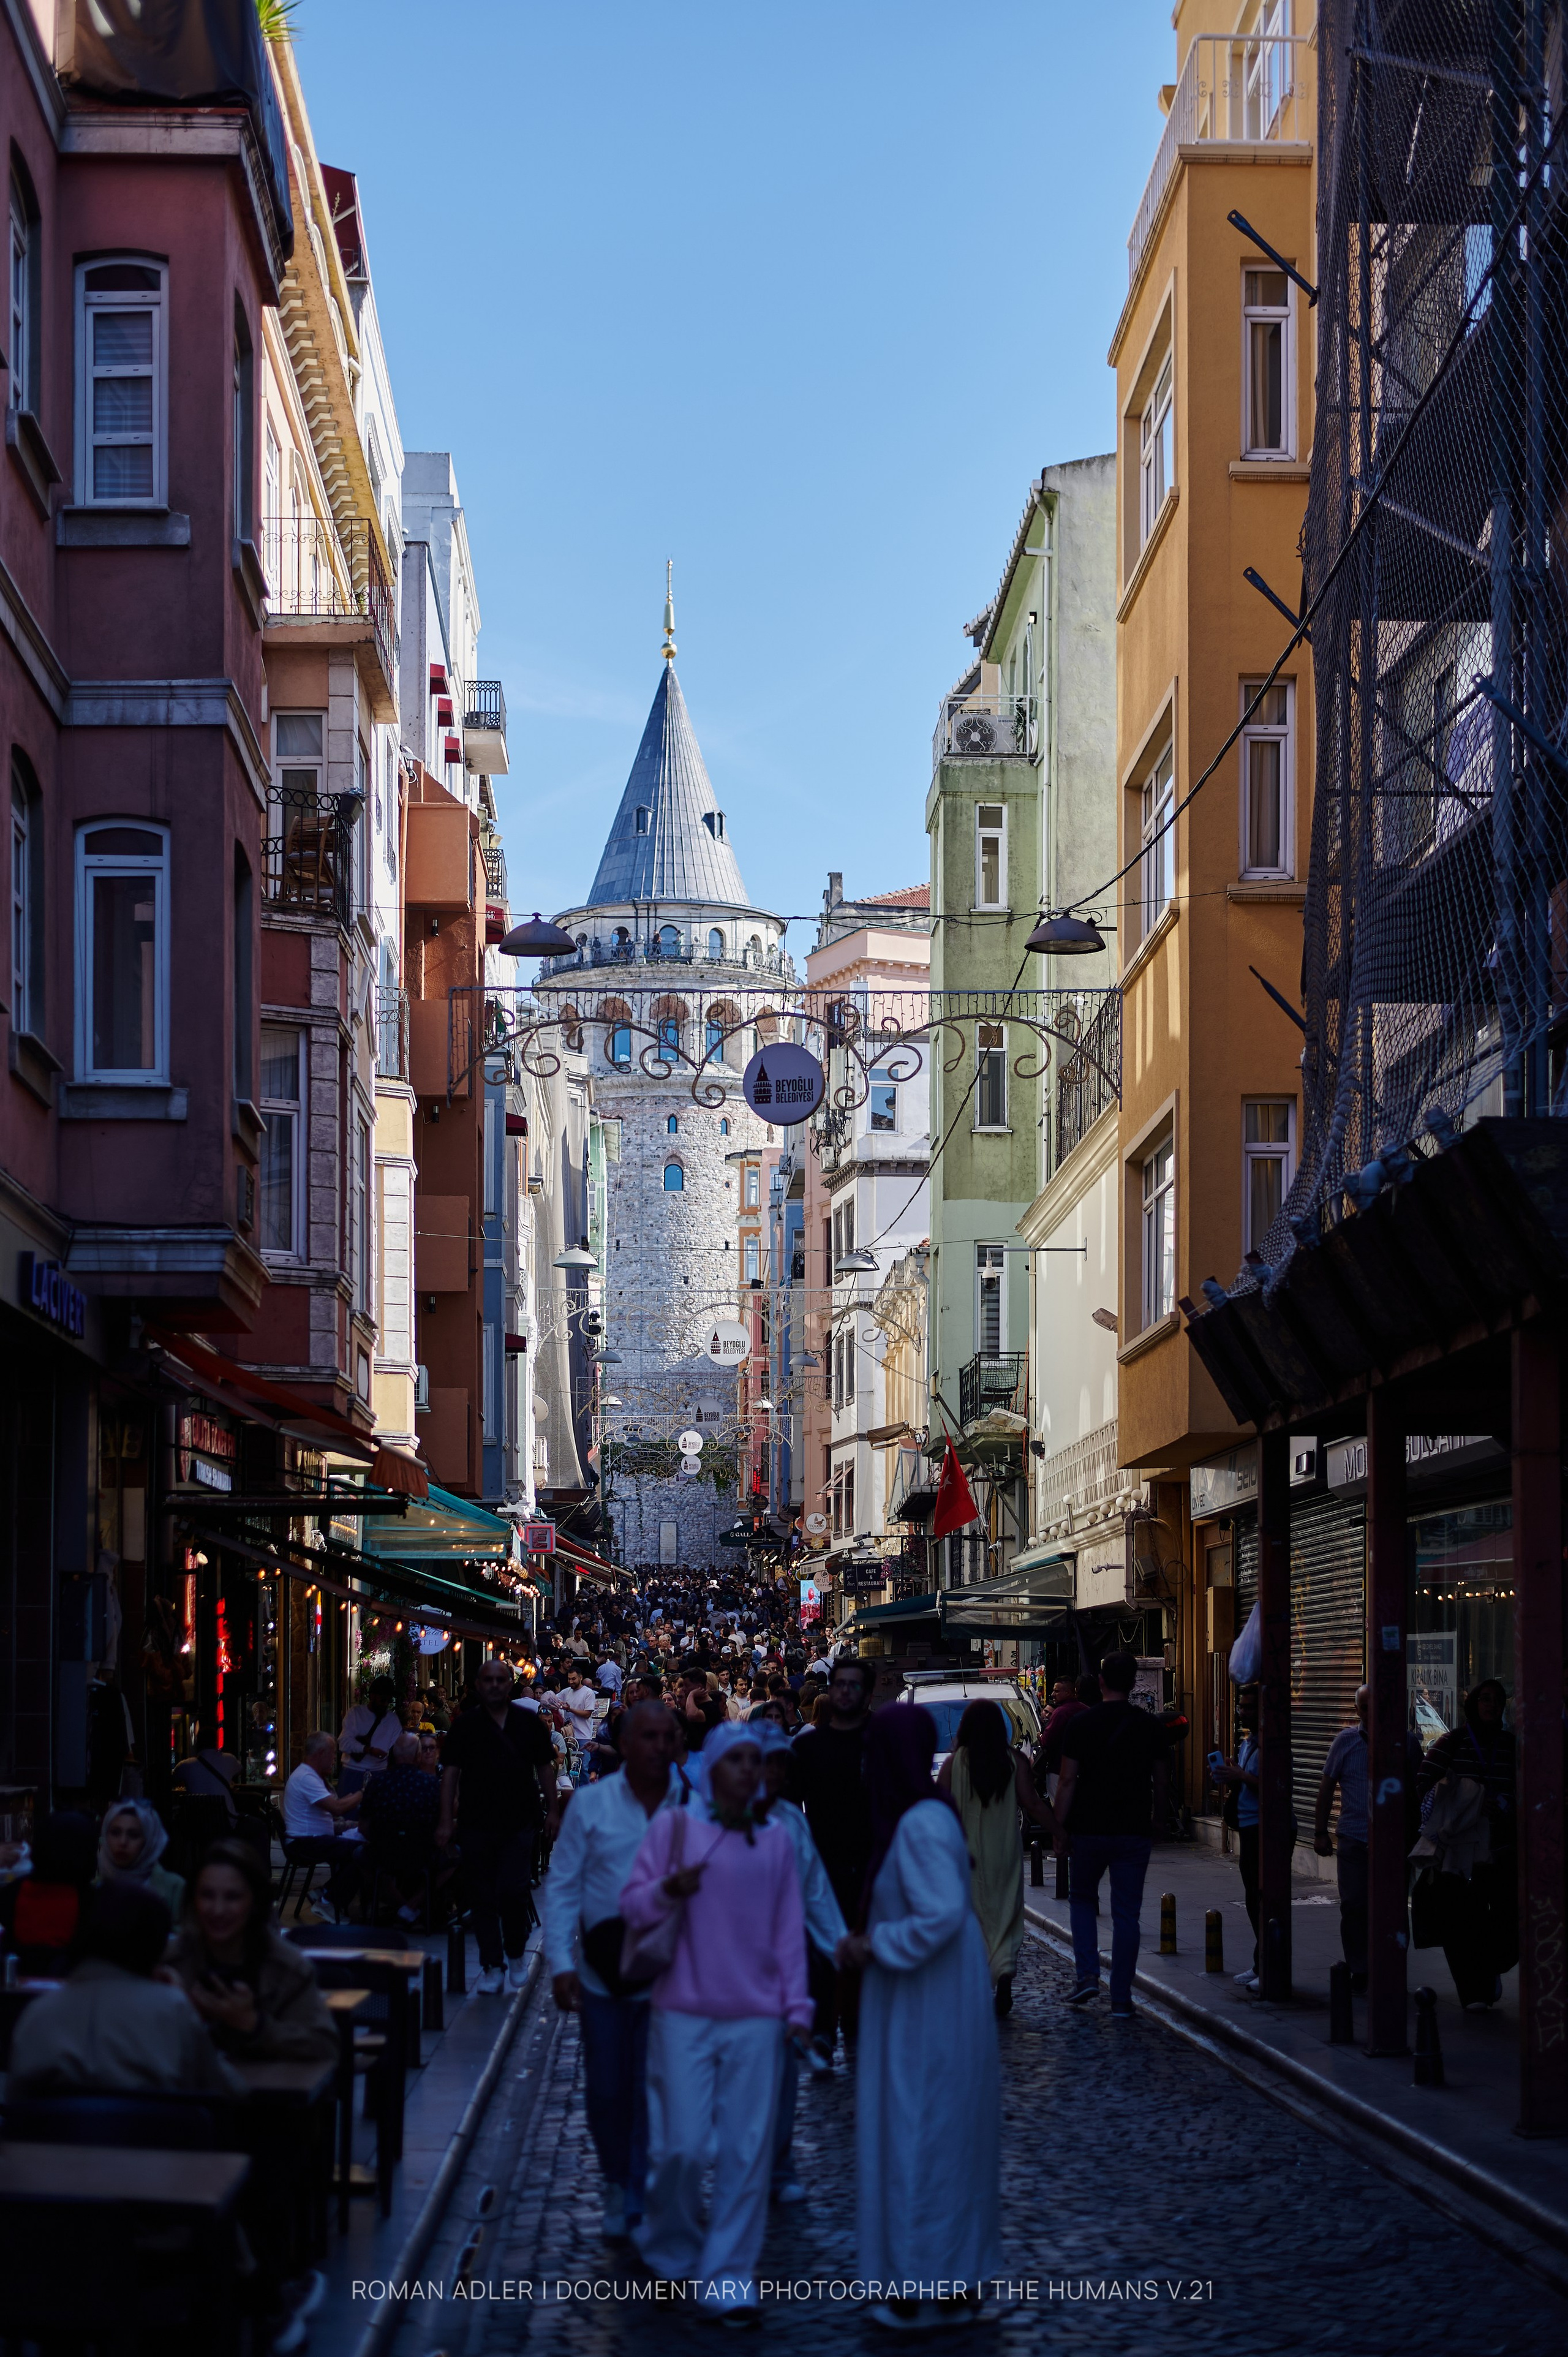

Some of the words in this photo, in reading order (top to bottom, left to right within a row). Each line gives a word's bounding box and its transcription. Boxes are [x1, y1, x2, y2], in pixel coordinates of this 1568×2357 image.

[775, 1076, 813, 1092] BEYOĞLU
[775, 1091, 813, 1103] BELEDİYESİ
[723, 1339, 745, 1348] BEYOĞLU
[1411, 1665, 1432, 1685] KİRALIK
[1434, 1665, 1449, 1686] BİNA
